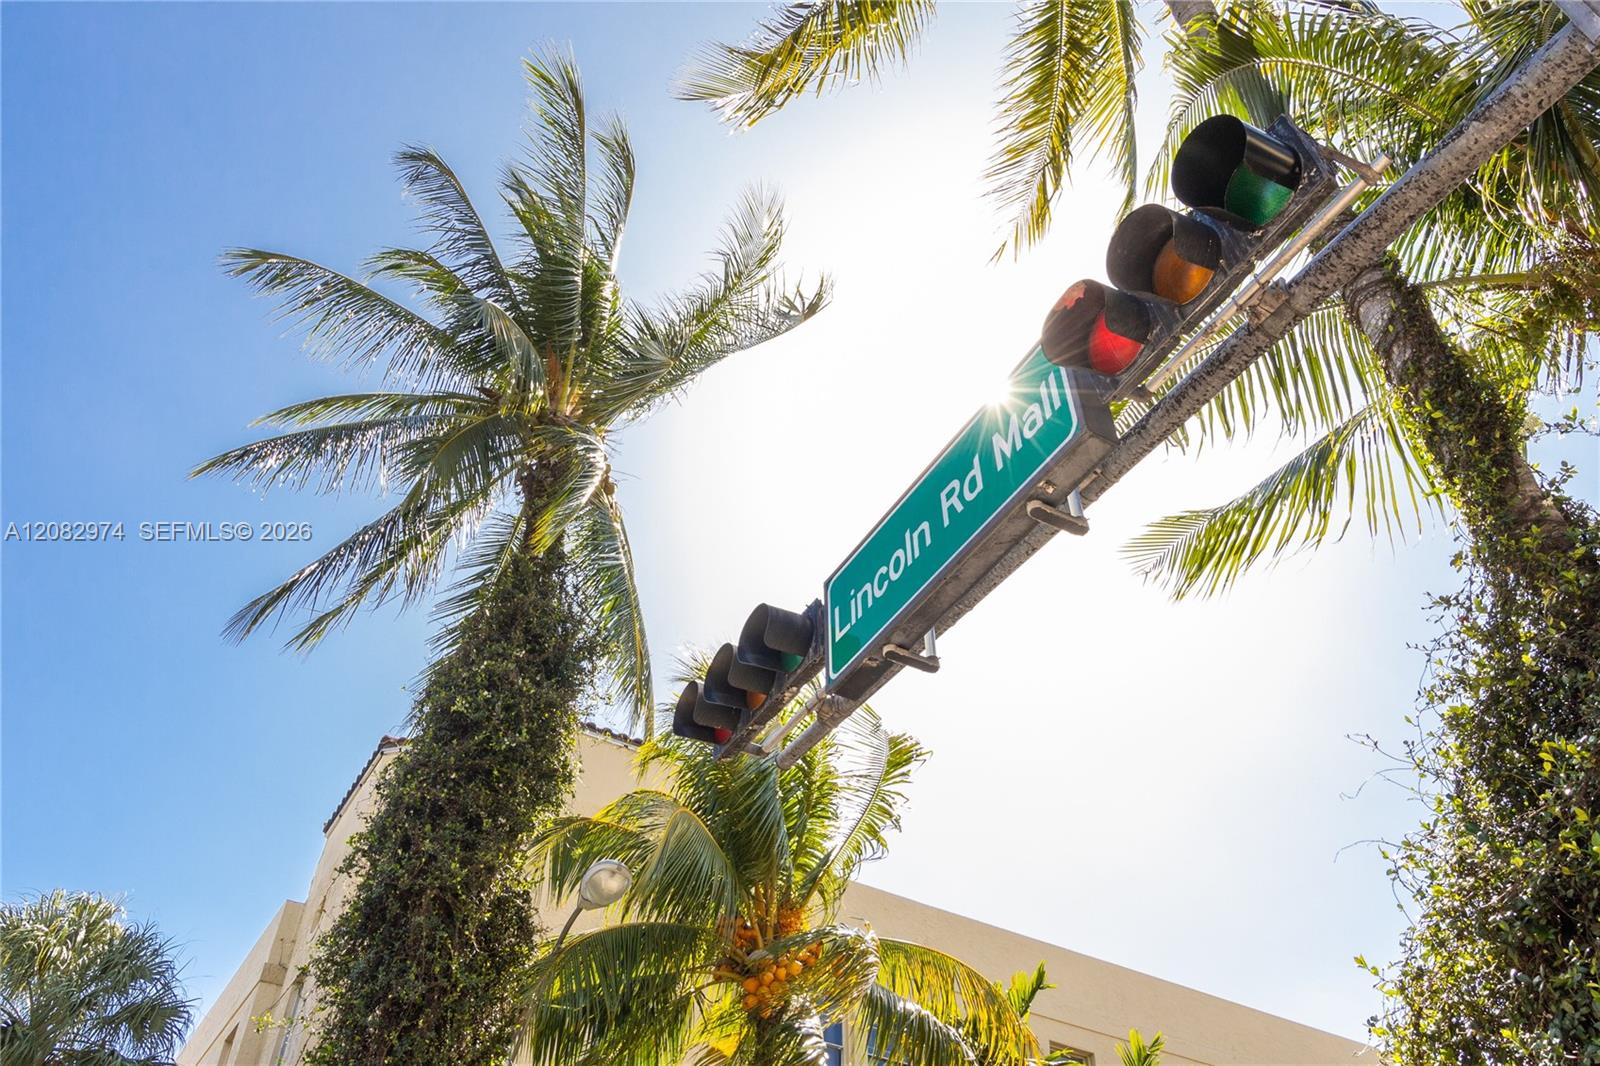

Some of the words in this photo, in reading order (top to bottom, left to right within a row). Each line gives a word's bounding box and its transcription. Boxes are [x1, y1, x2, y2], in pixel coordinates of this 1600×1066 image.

[834, 520, 931, 642] Lincoln
[940, 454, 984, 528] Rd
[991, 370, 1061, 472] Mall
